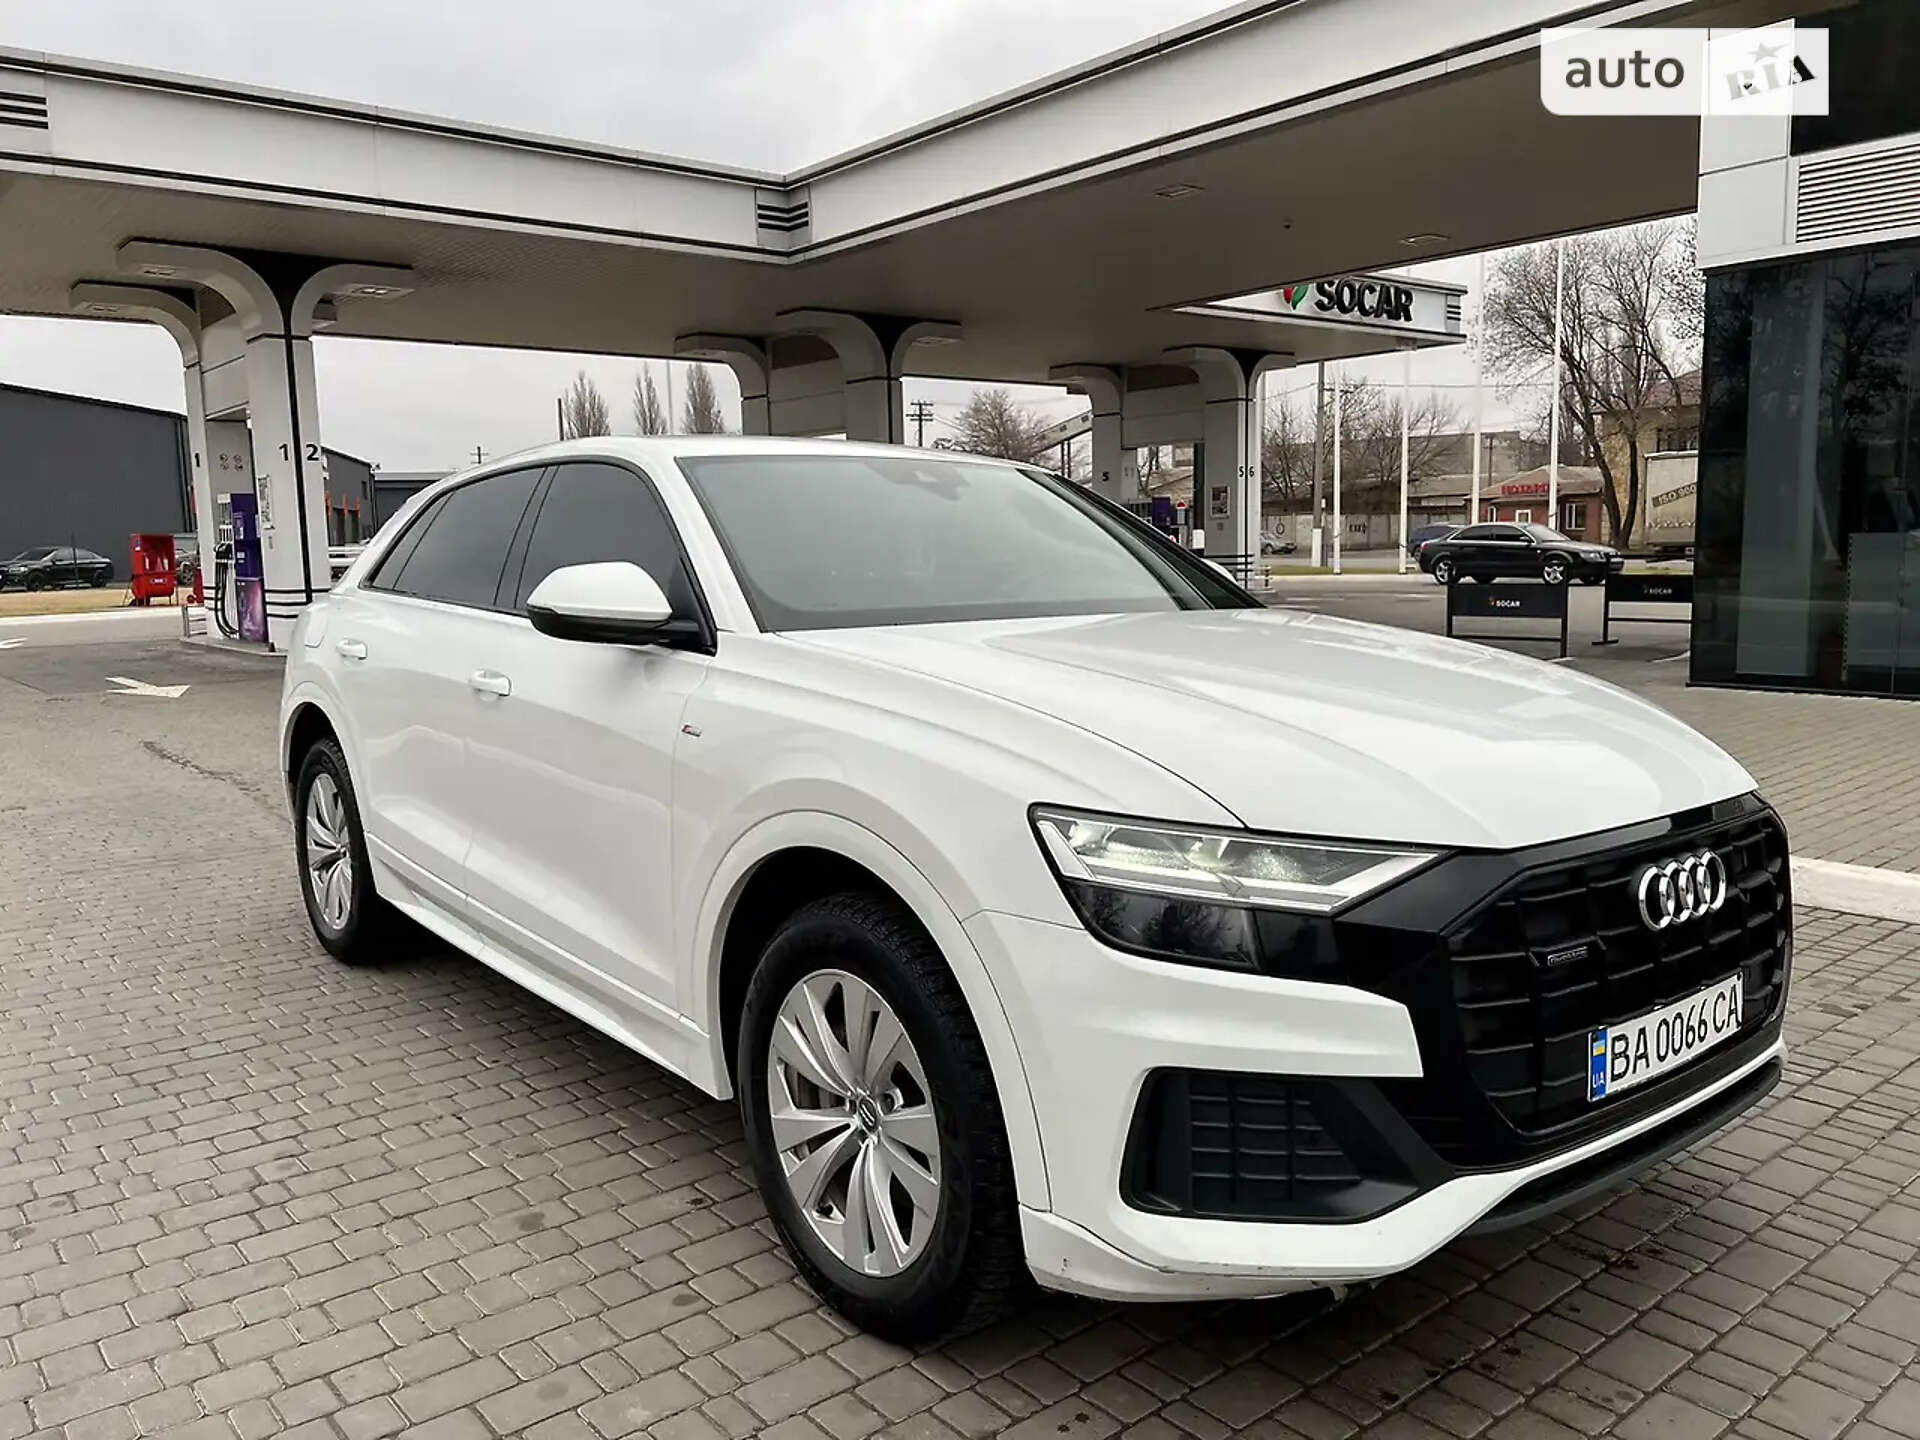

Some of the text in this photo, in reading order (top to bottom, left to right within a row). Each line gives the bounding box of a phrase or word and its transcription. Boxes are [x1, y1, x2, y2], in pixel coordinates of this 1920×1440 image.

[1314, 278, 1414, 322] SOCAR
[279, 443, 320, 461] 1 2
[1658, 490, 1676, 505] ISO
[1496, 599, 1521, 608] SOCAR
[1610, 983, 1742, 1083] BA 0066 CA
[1592, 1071, 1606, 1088] UA
